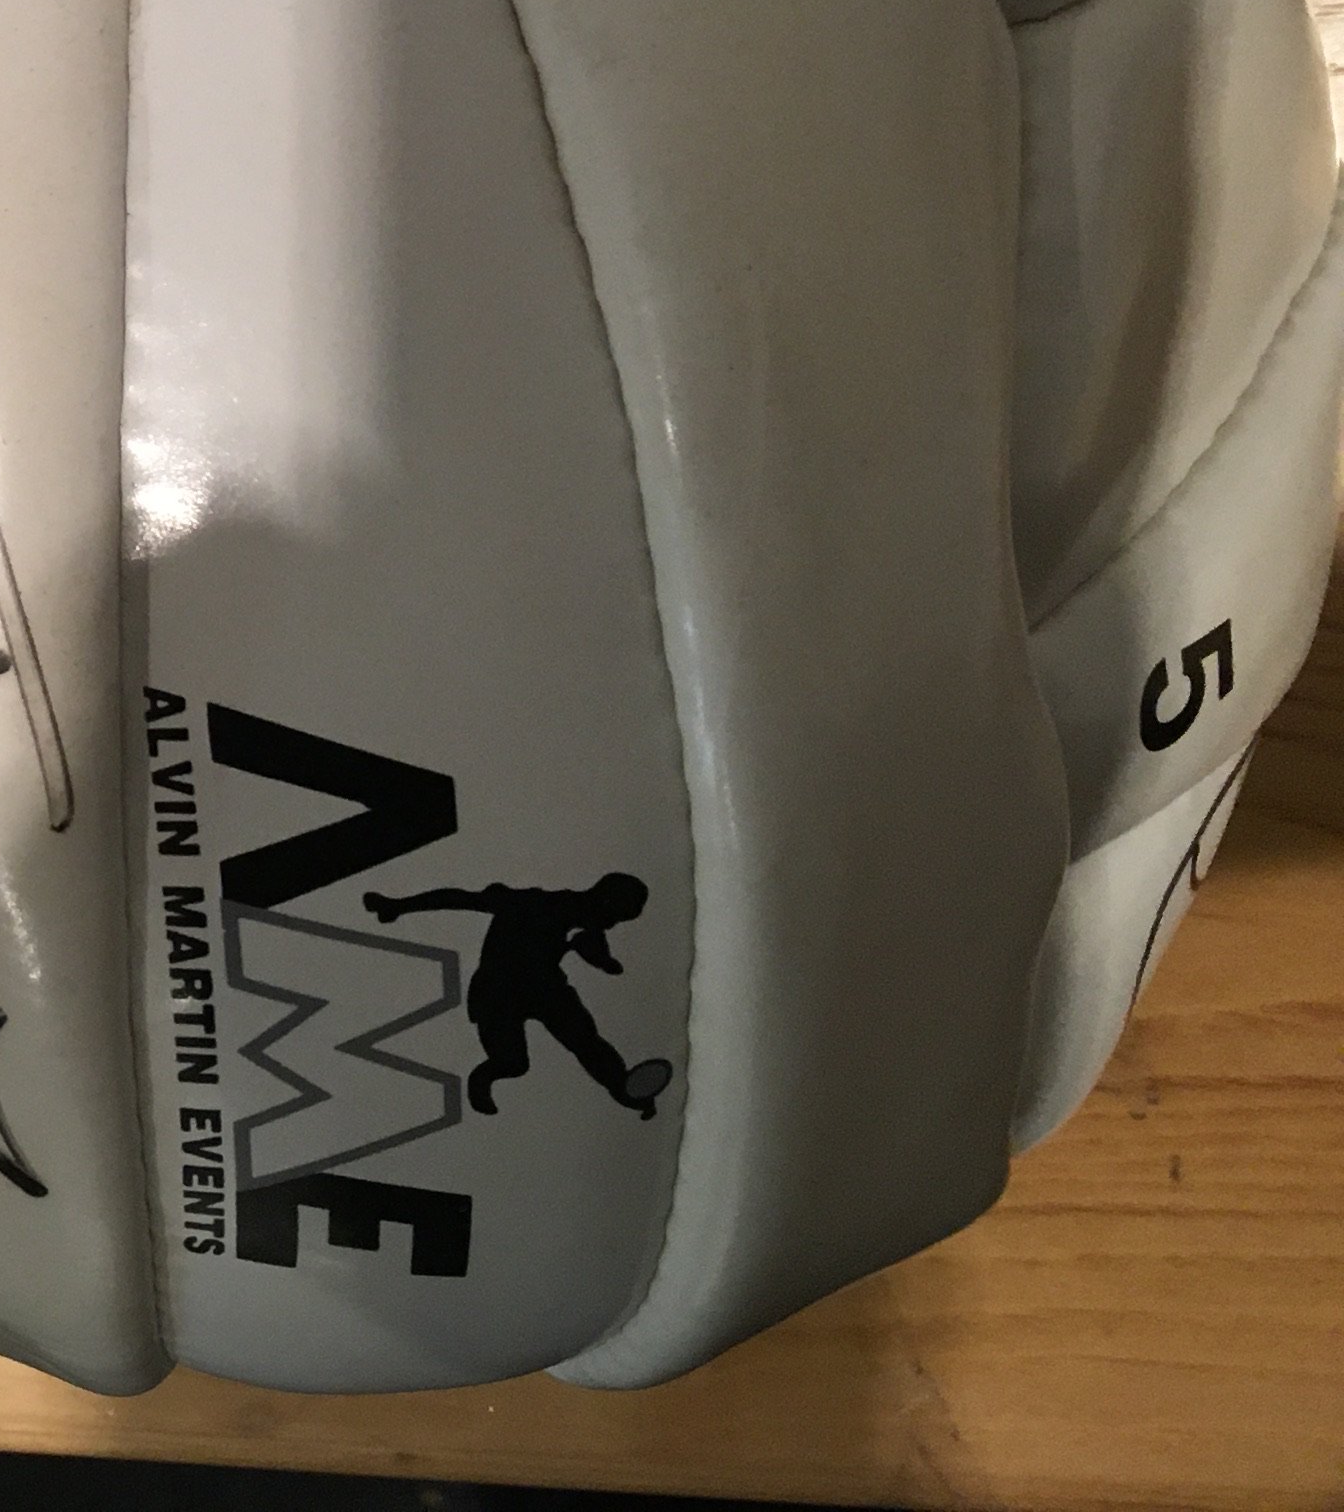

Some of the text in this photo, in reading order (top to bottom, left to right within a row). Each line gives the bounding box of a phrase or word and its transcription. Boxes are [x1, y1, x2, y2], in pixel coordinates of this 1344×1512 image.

[1138, 618, 1234, 752] 5
[142, 685, 226, 1257] ALVIN MARTIN EVENTS
